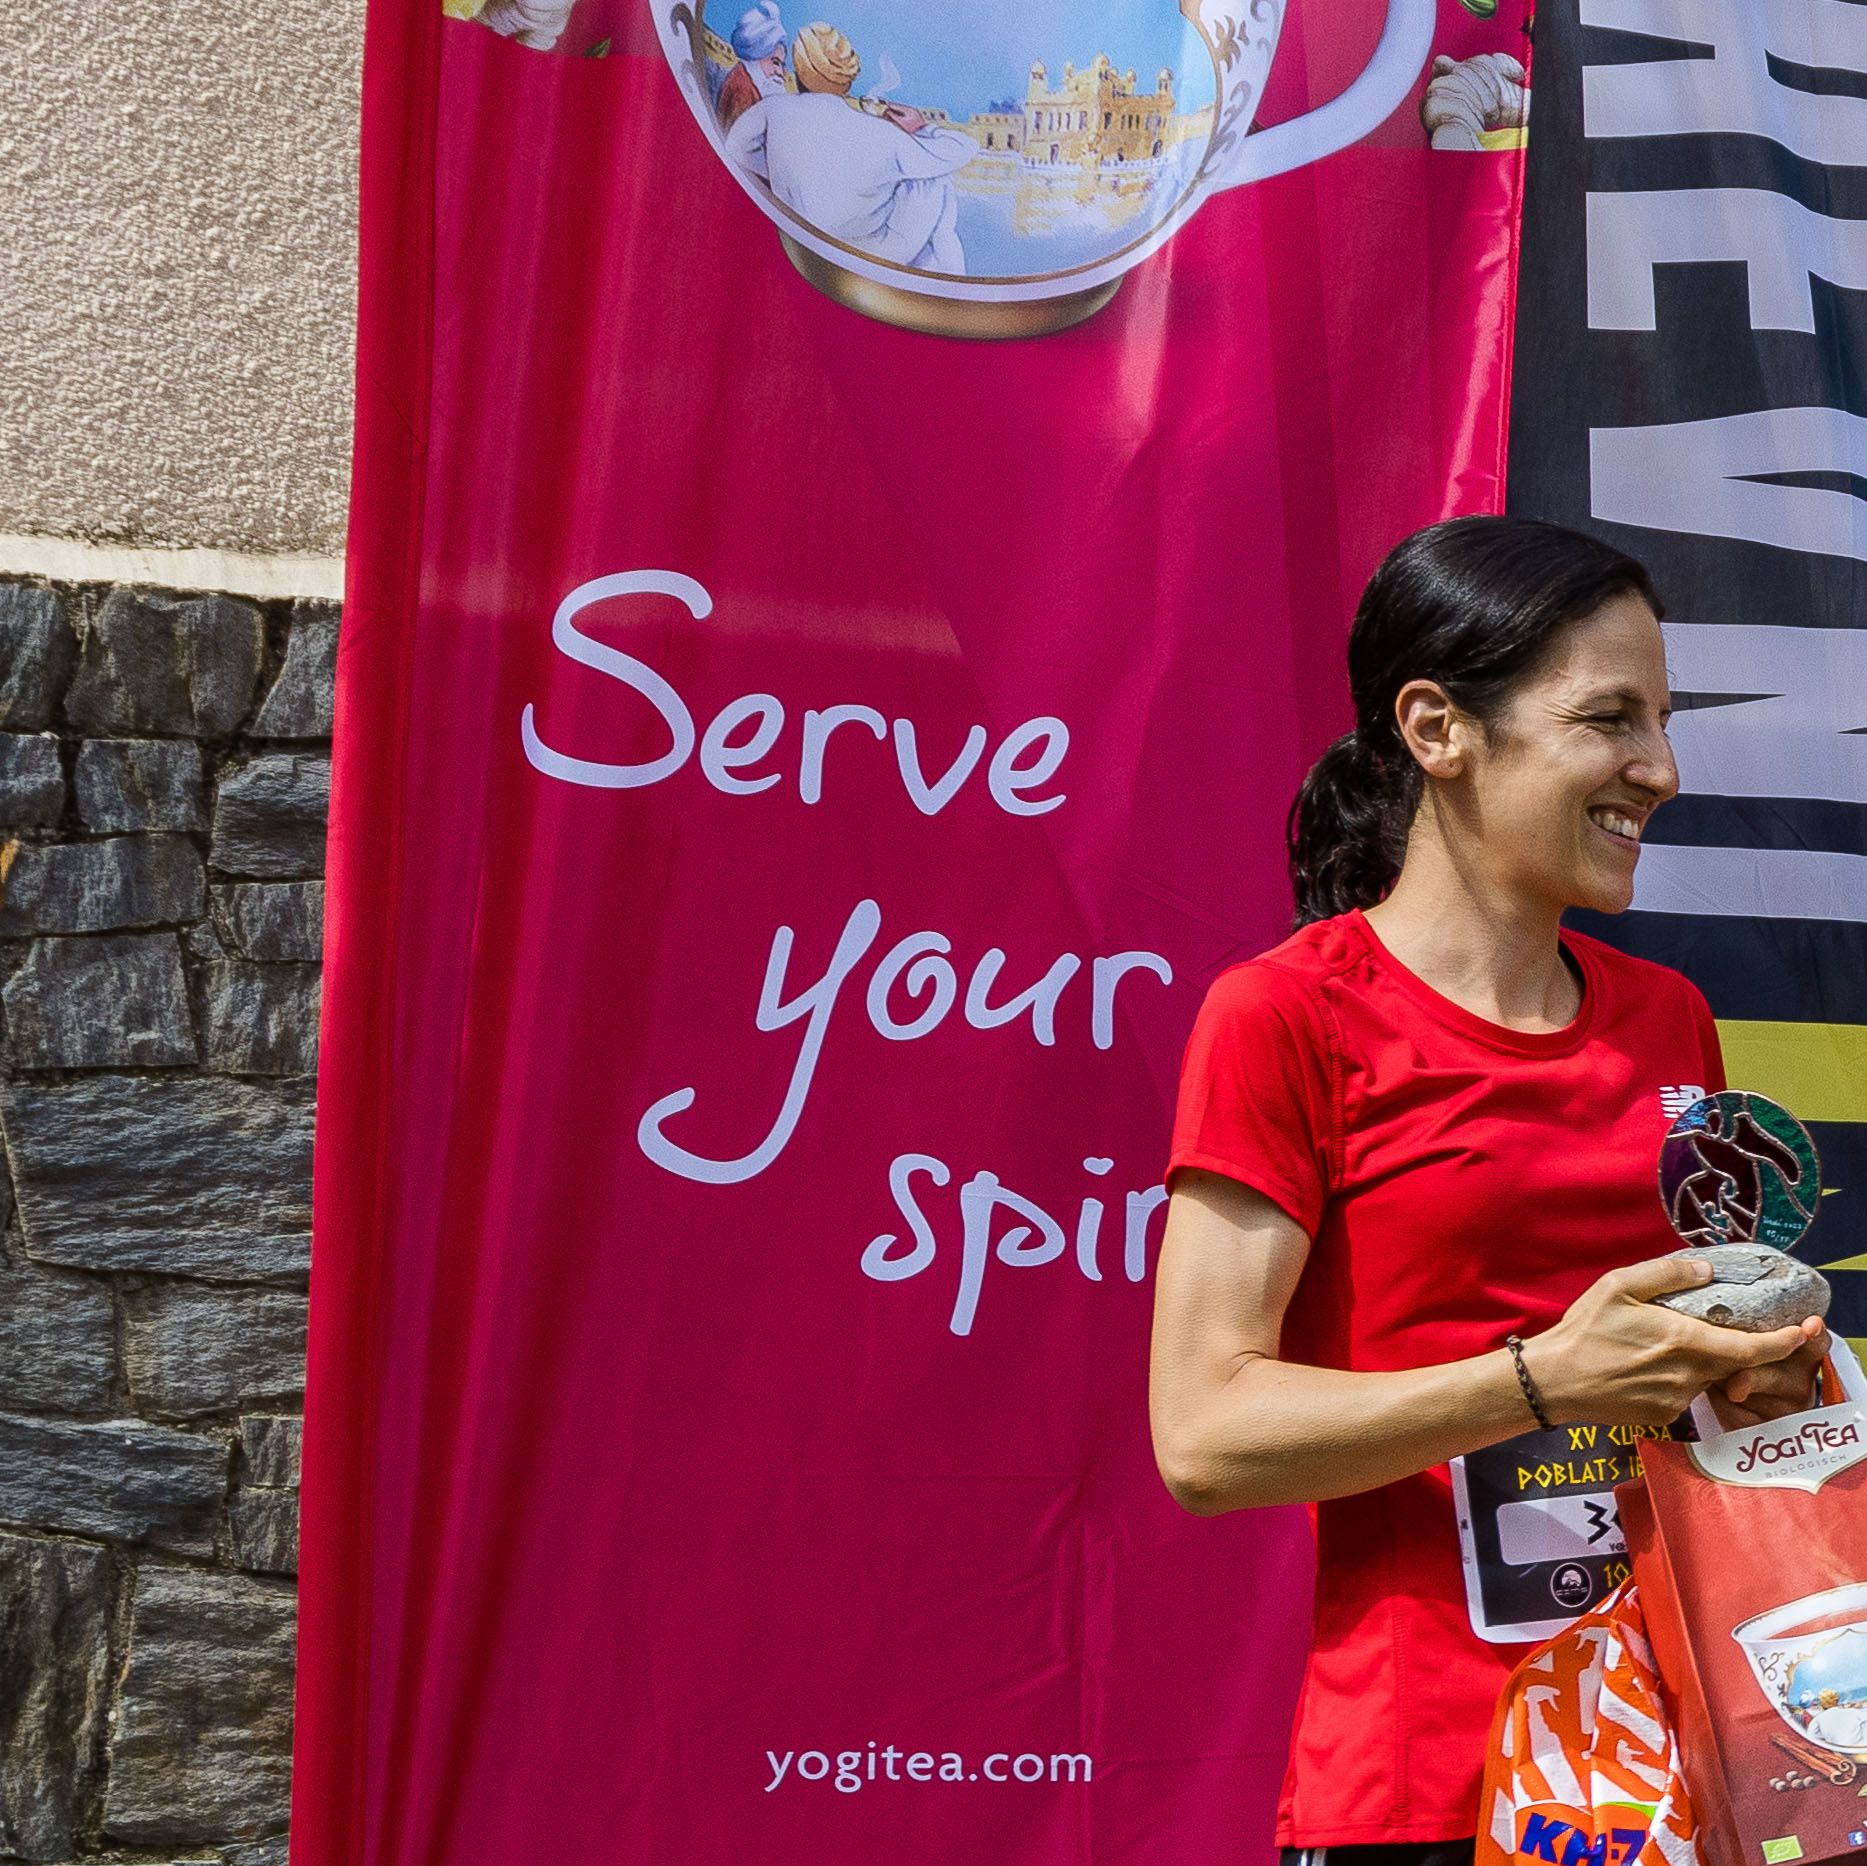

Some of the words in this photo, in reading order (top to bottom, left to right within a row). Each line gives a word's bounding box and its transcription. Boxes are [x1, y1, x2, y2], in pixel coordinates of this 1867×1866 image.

[521, 569, 1070, 816] Serve
[637, 898, 1173, 1184] your
[1567, 1425, 1597, 1450] XV
[1518, 1457, 1620, 1490] POBLATS
[1765, 1454, 1847, 1479] BIOLOGISCH
[1583, 1500, 1622, 1545] 3
[764, 1741, 1093, 1793] yogitea.com
